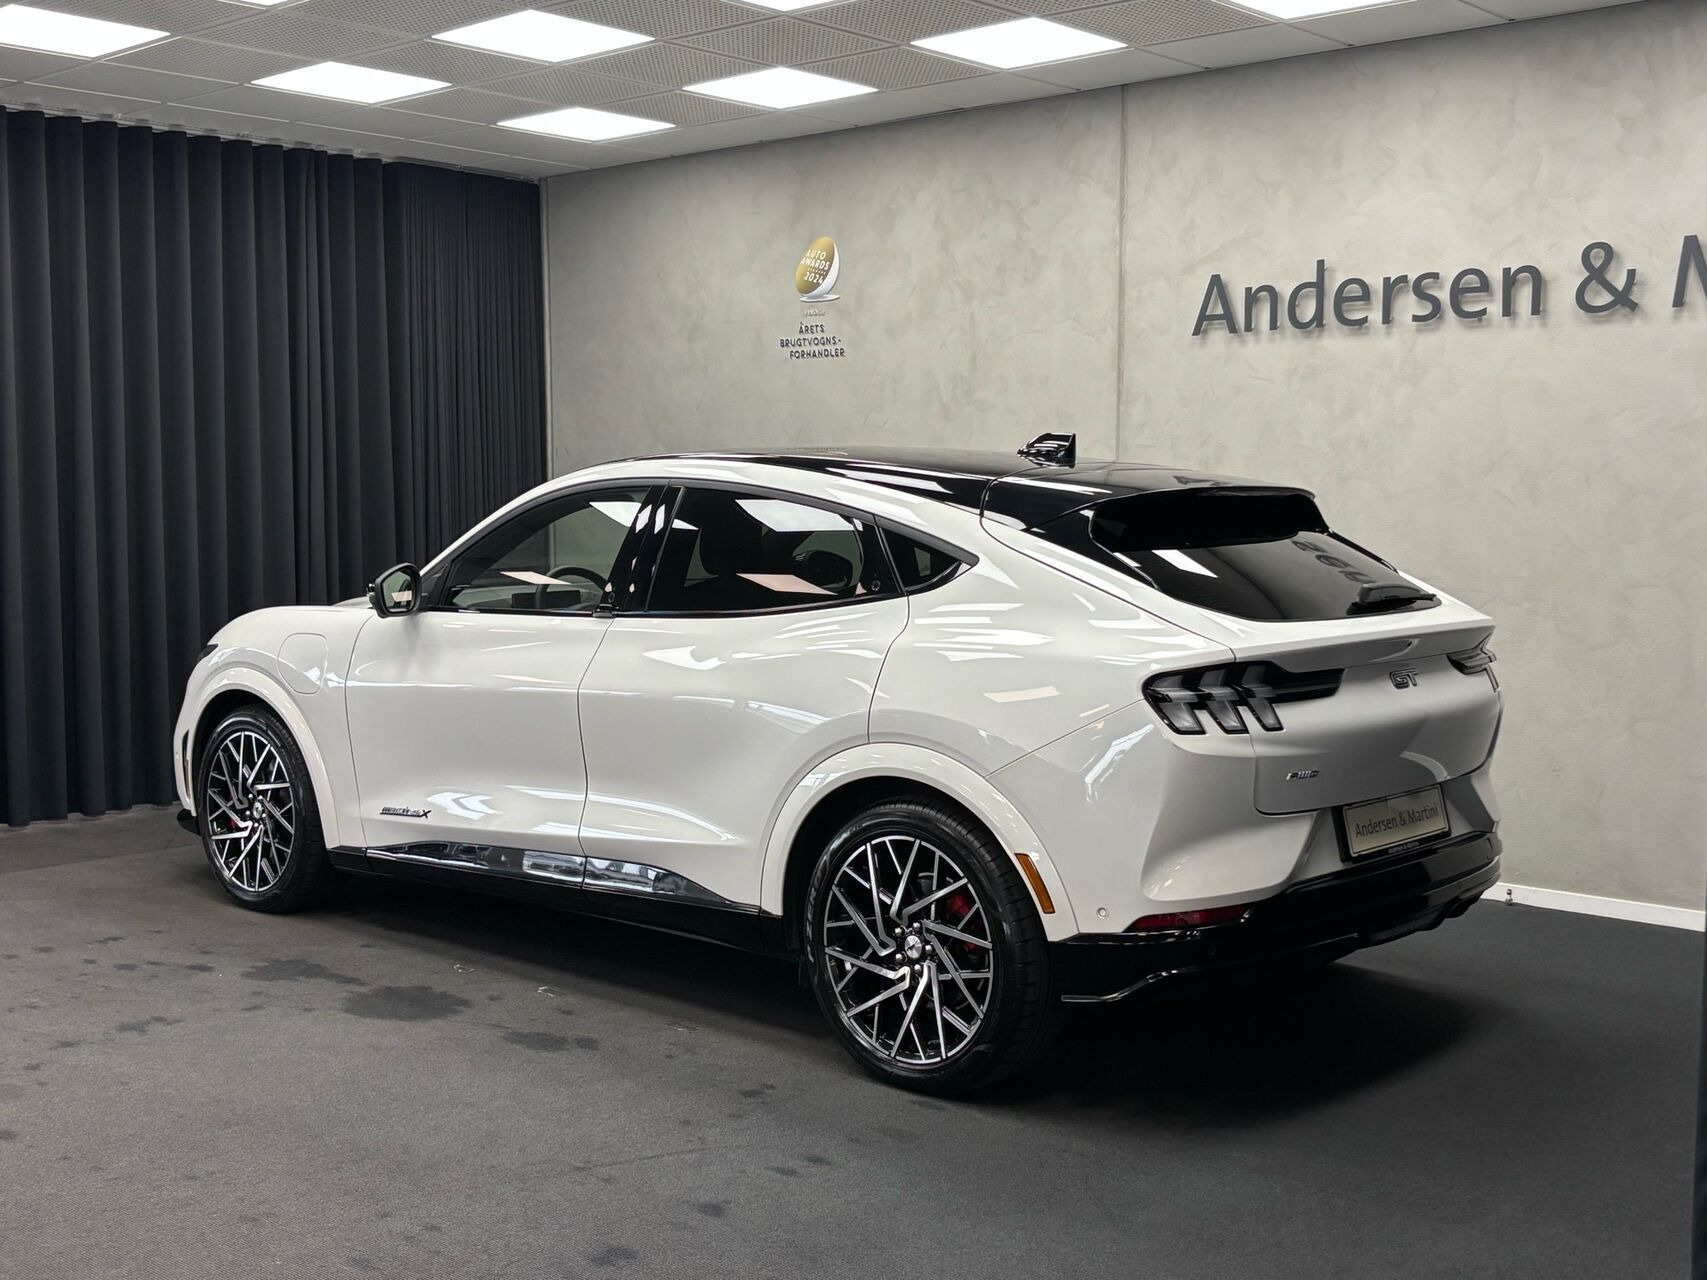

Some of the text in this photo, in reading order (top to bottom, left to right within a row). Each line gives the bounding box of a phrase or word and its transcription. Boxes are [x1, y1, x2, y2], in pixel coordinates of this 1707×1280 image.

[805, 249, 827, 260] AUTO
[799, 257, 830, 271] AWARDS
[1192, 258, 1543, 336] Andersen
[1574, 241, 1639, 314] &
[798, 321, 825, 334] ÅRETS
[779, 335, 842, 348] BRUGTVOGNS-
[789, 348, 846, 360] FORHANDLER
[1388, 668, 1419, 690] GT
[1355, 803, 1439, 838] Andersen & Martini
